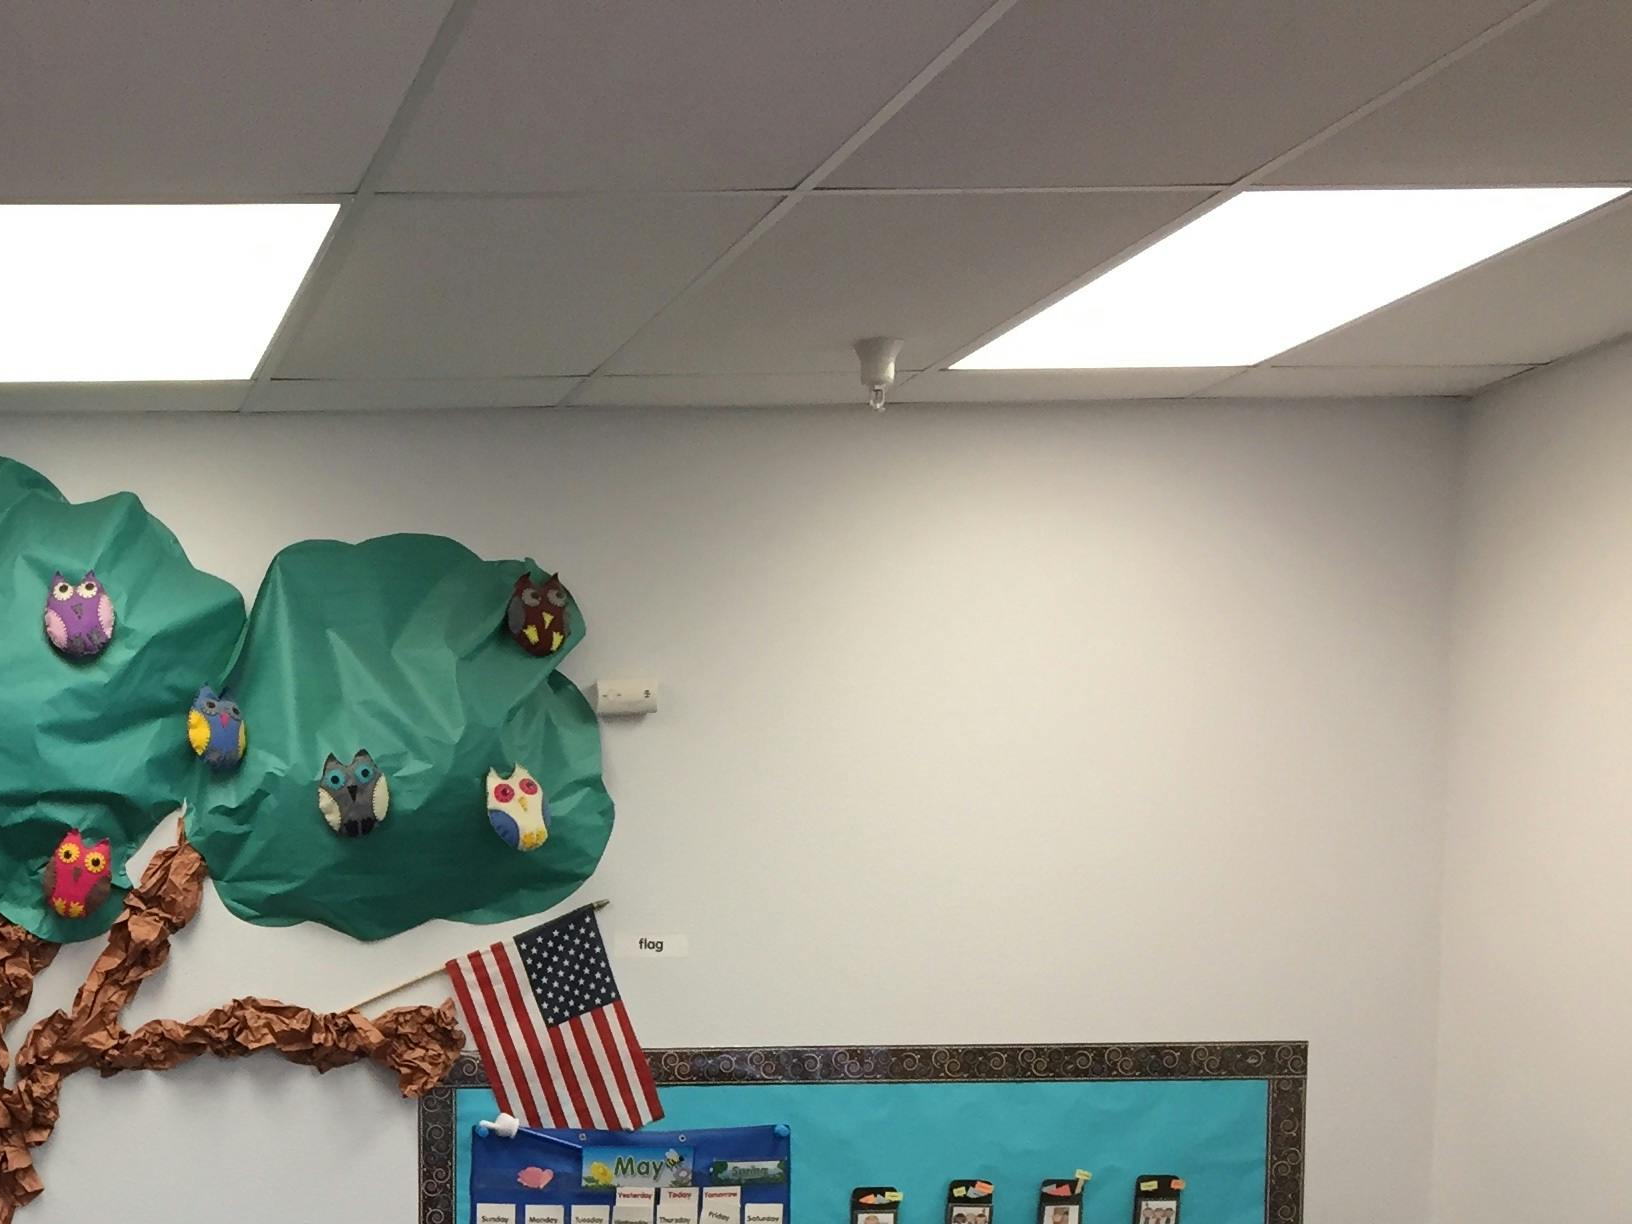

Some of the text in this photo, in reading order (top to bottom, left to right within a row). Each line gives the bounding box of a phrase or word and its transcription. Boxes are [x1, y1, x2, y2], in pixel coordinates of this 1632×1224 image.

[639, 938, 663, 952] flag
[614, 1157, 664, 1180] May
[618, 1192, 653, 1200] Yesterday
[668, 1192, 692, 1200] Today
[481, 1216, 509, 1224] Sunday
[529, 1217, 558, 1224] Monday
[575, 1217, 603, 1224] Tuesday
[659, 1216, 691, 1224] Thursday
[708, 1211, 730, 1222] Friday
[746, 1215, 780, 1223] Saturday
